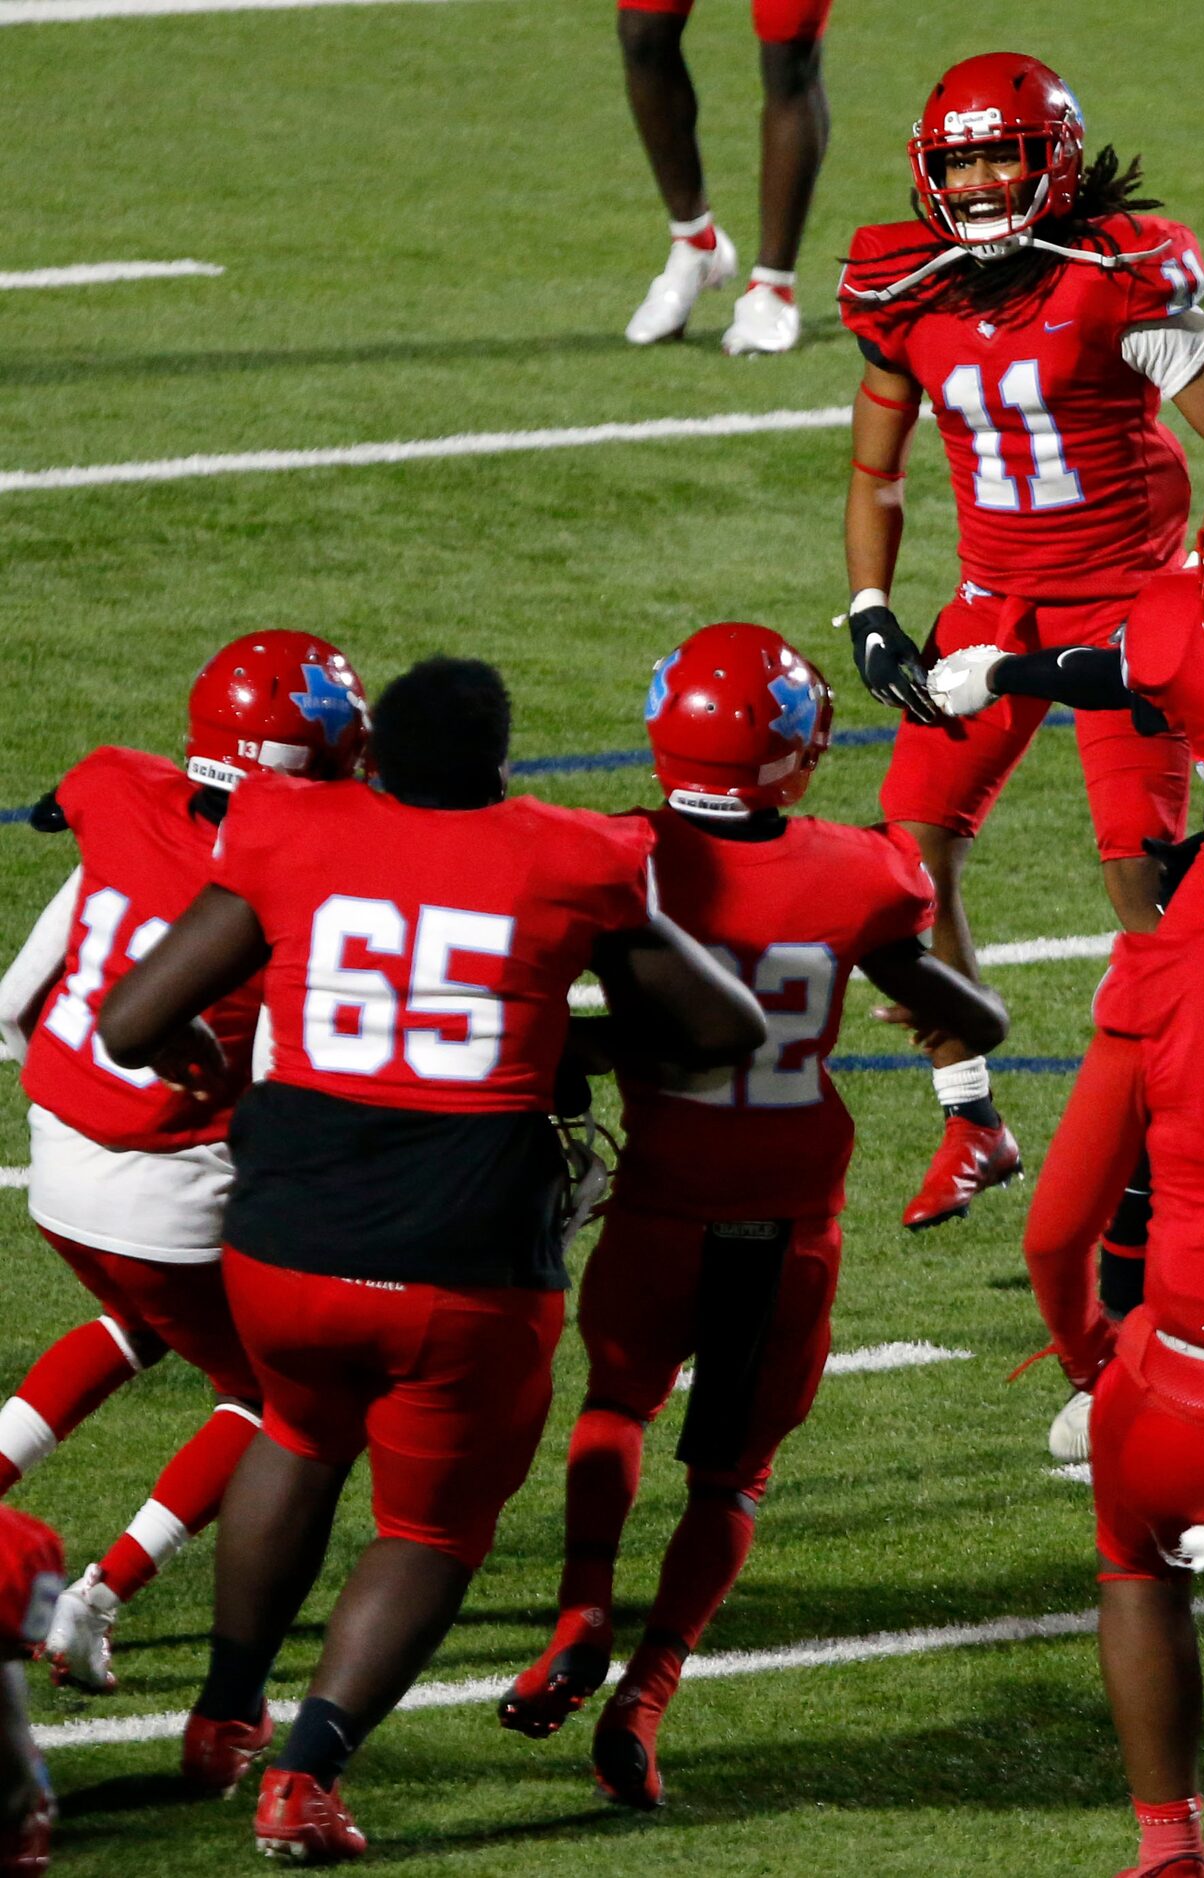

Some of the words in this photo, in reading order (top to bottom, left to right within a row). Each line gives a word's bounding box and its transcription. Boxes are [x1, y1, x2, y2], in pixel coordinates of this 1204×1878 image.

[942, 359, 1087, 511] 11
[237, 739, 259, 760] 13
[303, 893, 517, 1082] 65
